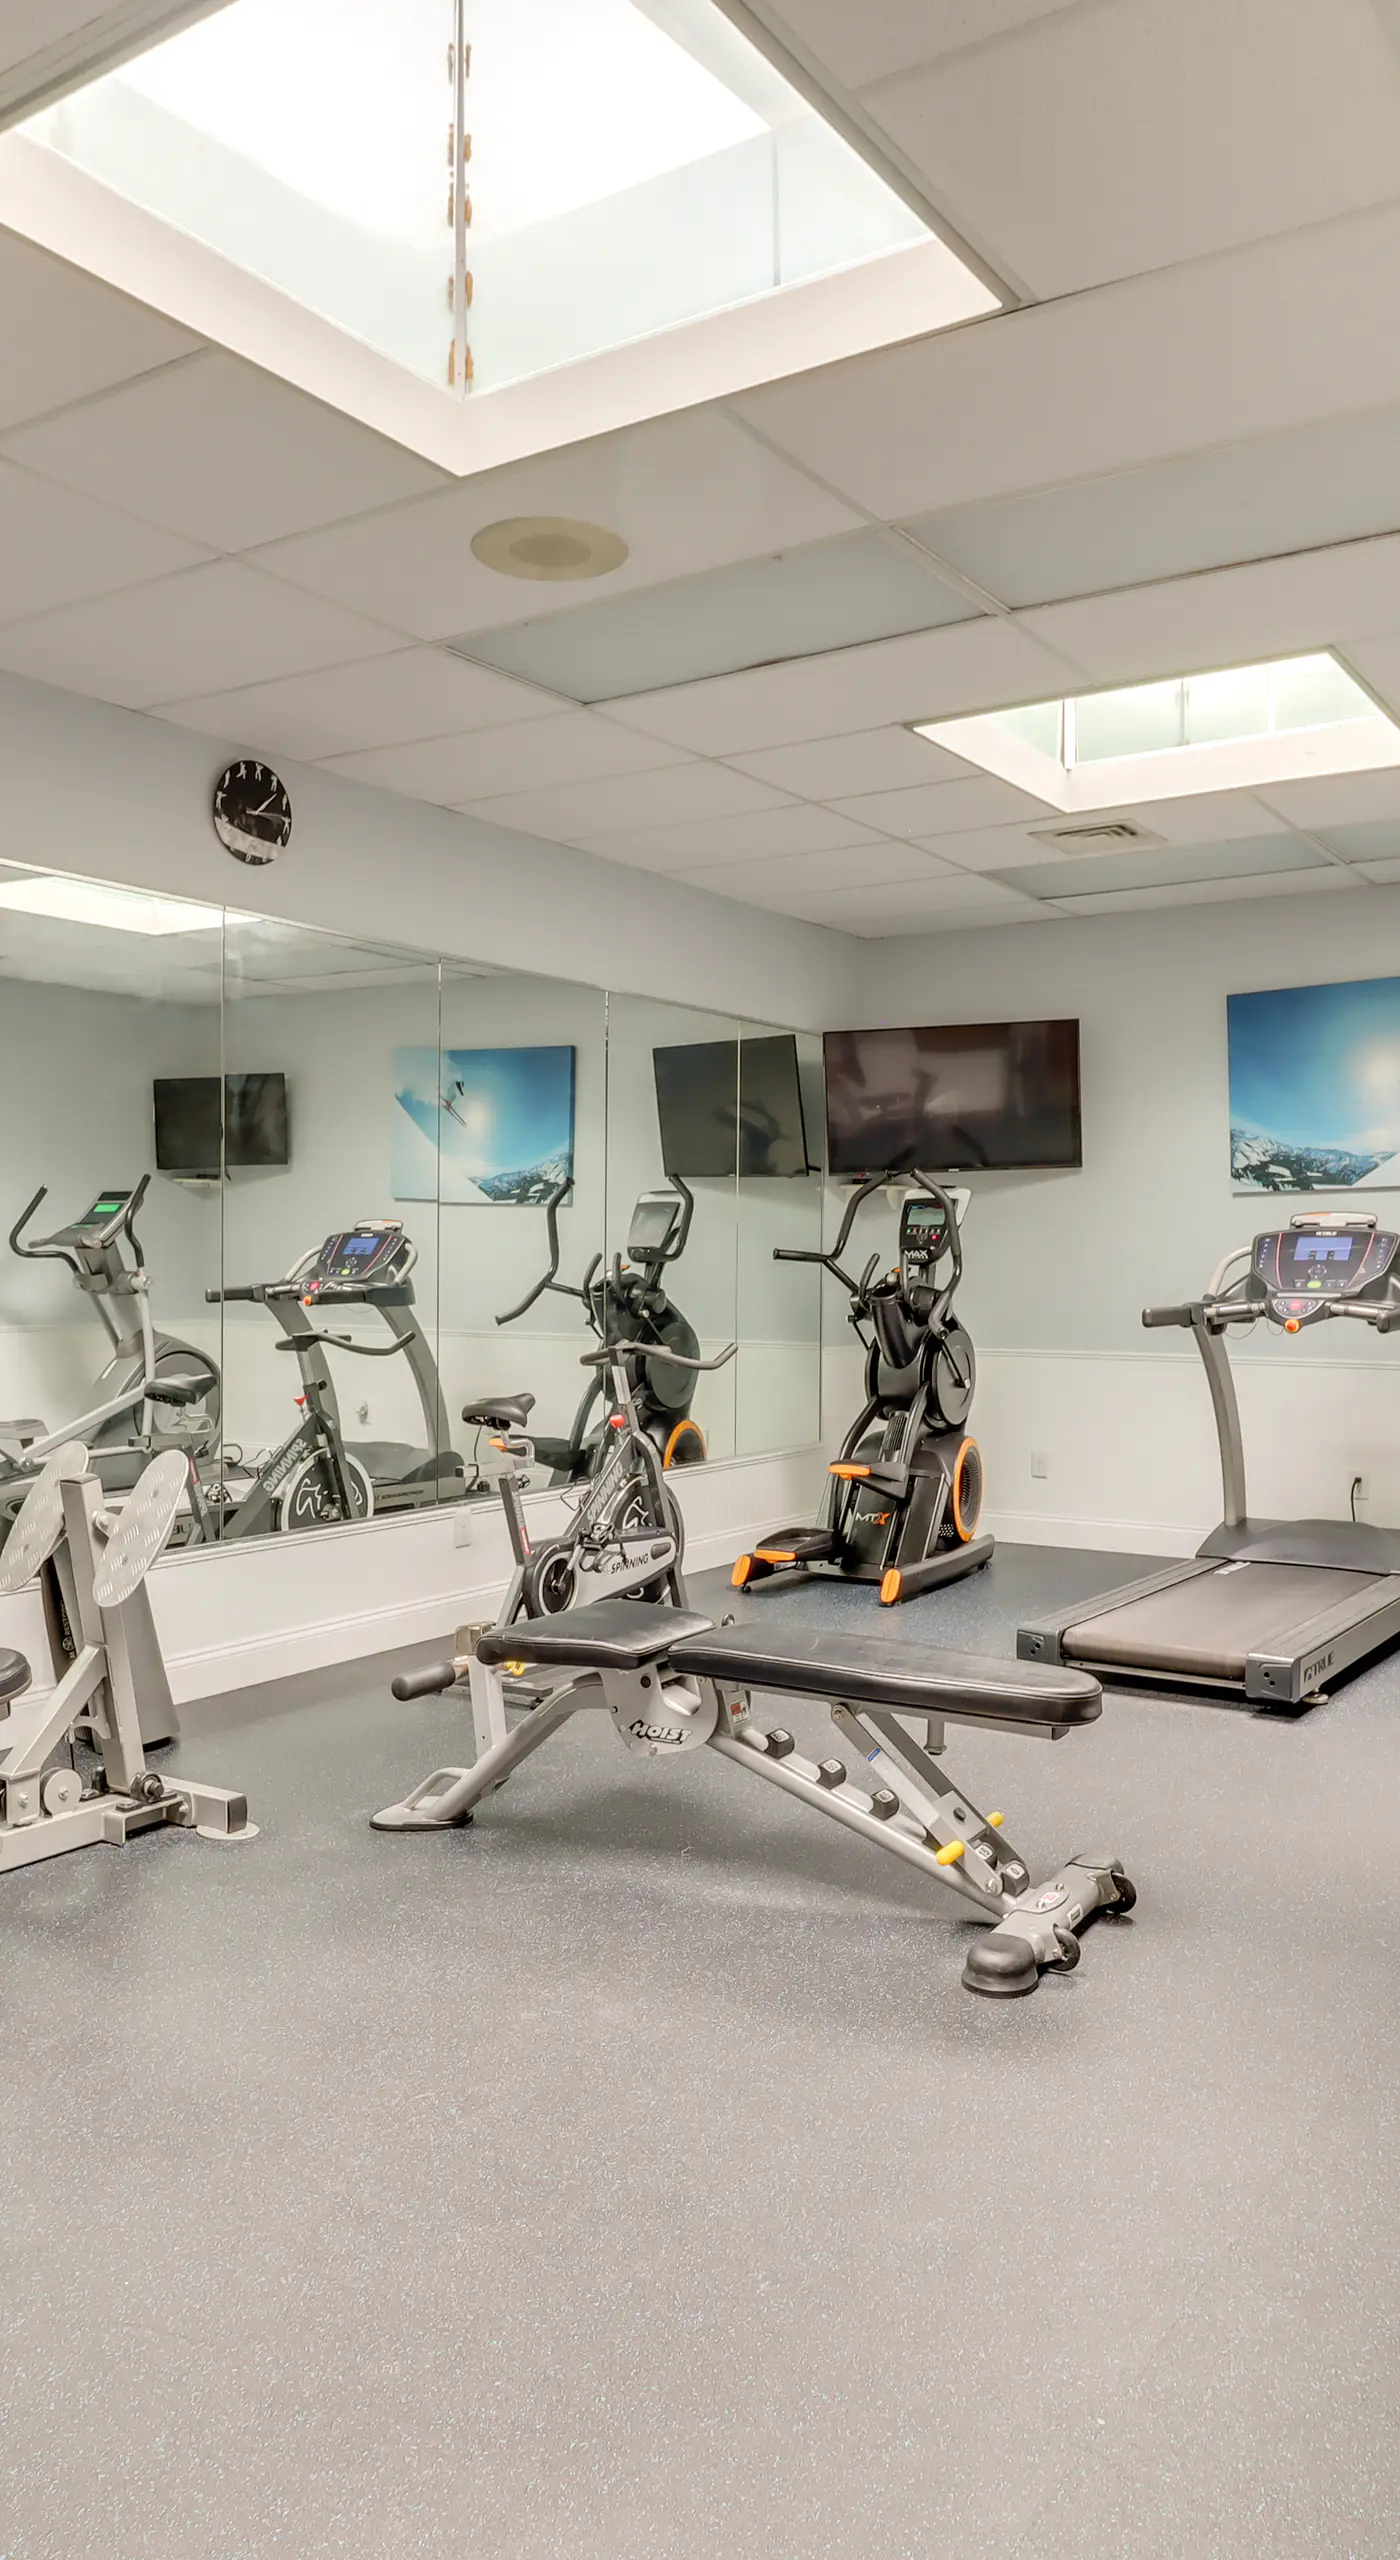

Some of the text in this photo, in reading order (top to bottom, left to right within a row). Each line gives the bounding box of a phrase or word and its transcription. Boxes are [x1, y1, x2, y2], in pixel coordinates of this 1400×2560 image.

[904, 1249, 929, 1260] MAX
[586, 1463, 624, 1522] SPINNING
[855, 1511, 891, 1525] MTX
[611, 1553, 649, 1575] SPINNING
[630, 1721, 694, 1742] HOIST
